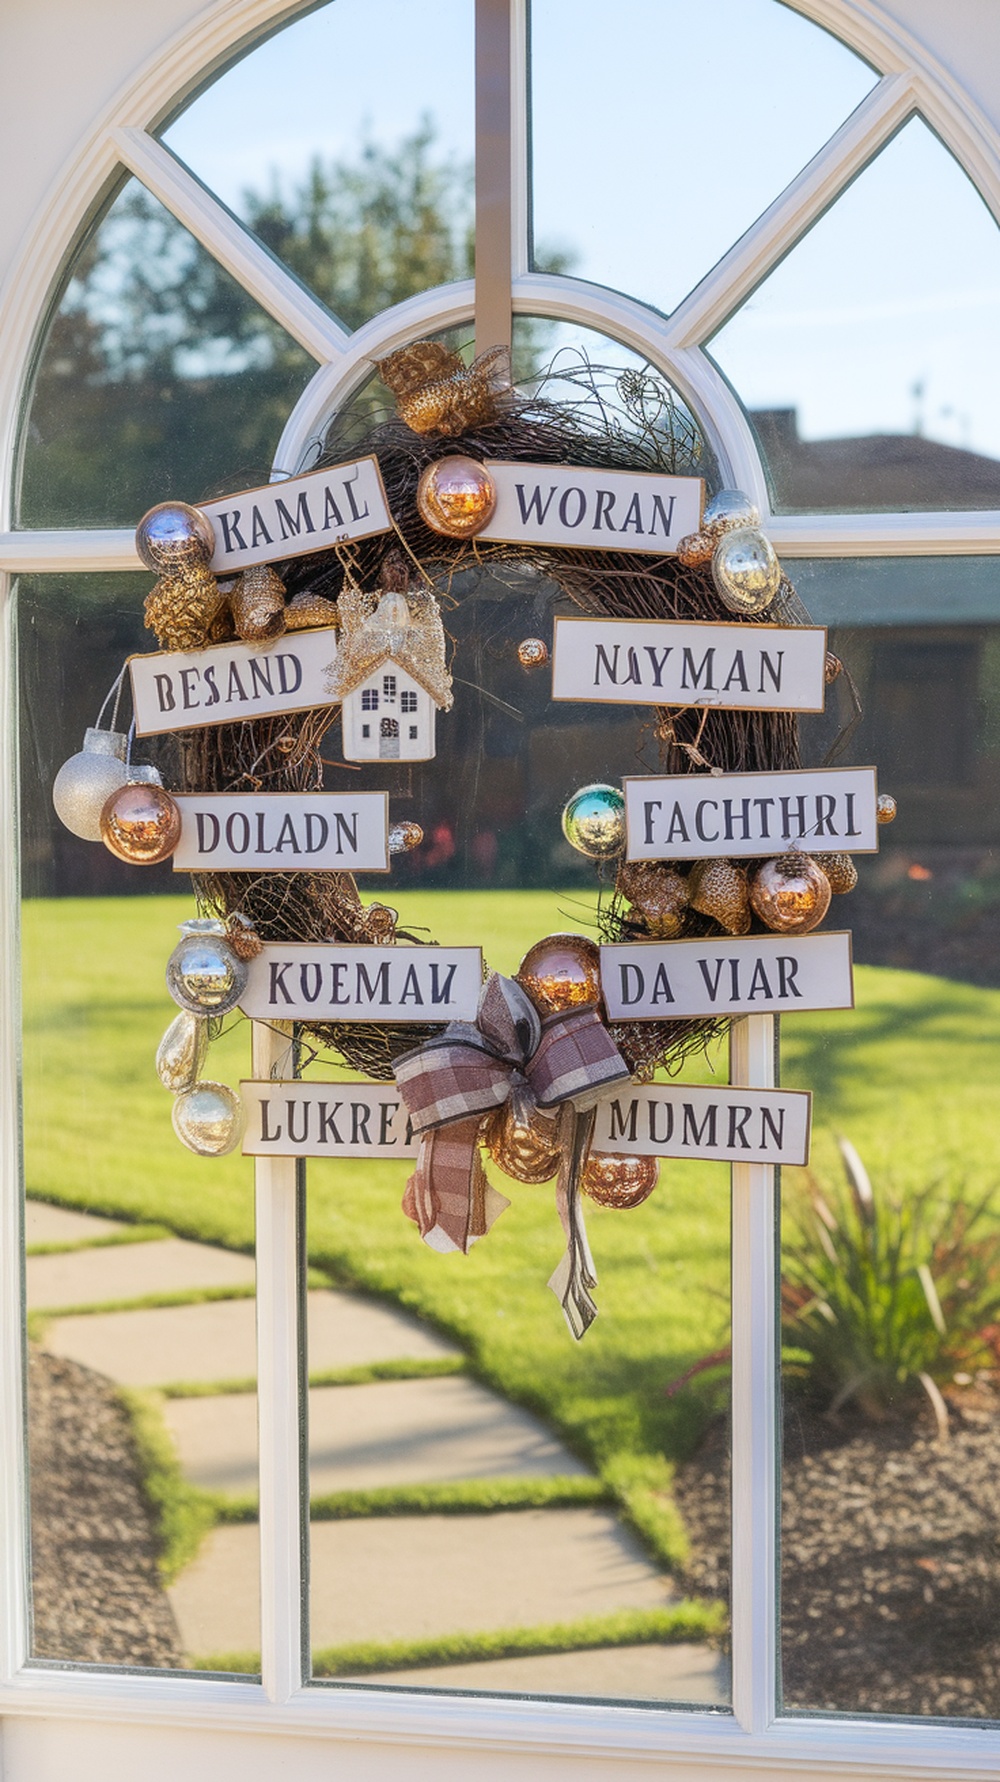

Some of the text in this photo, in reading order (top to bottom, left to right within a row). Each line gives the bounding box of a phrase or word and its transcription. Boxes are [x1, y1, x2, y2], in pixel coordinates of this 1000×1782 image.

[515, 484, 677, 537] WORAN
[154, 654, 302, 712] BESAND
[195, 812, 359, 854] DOLADN
[618, 956, 803, 1005] DA VIAR
